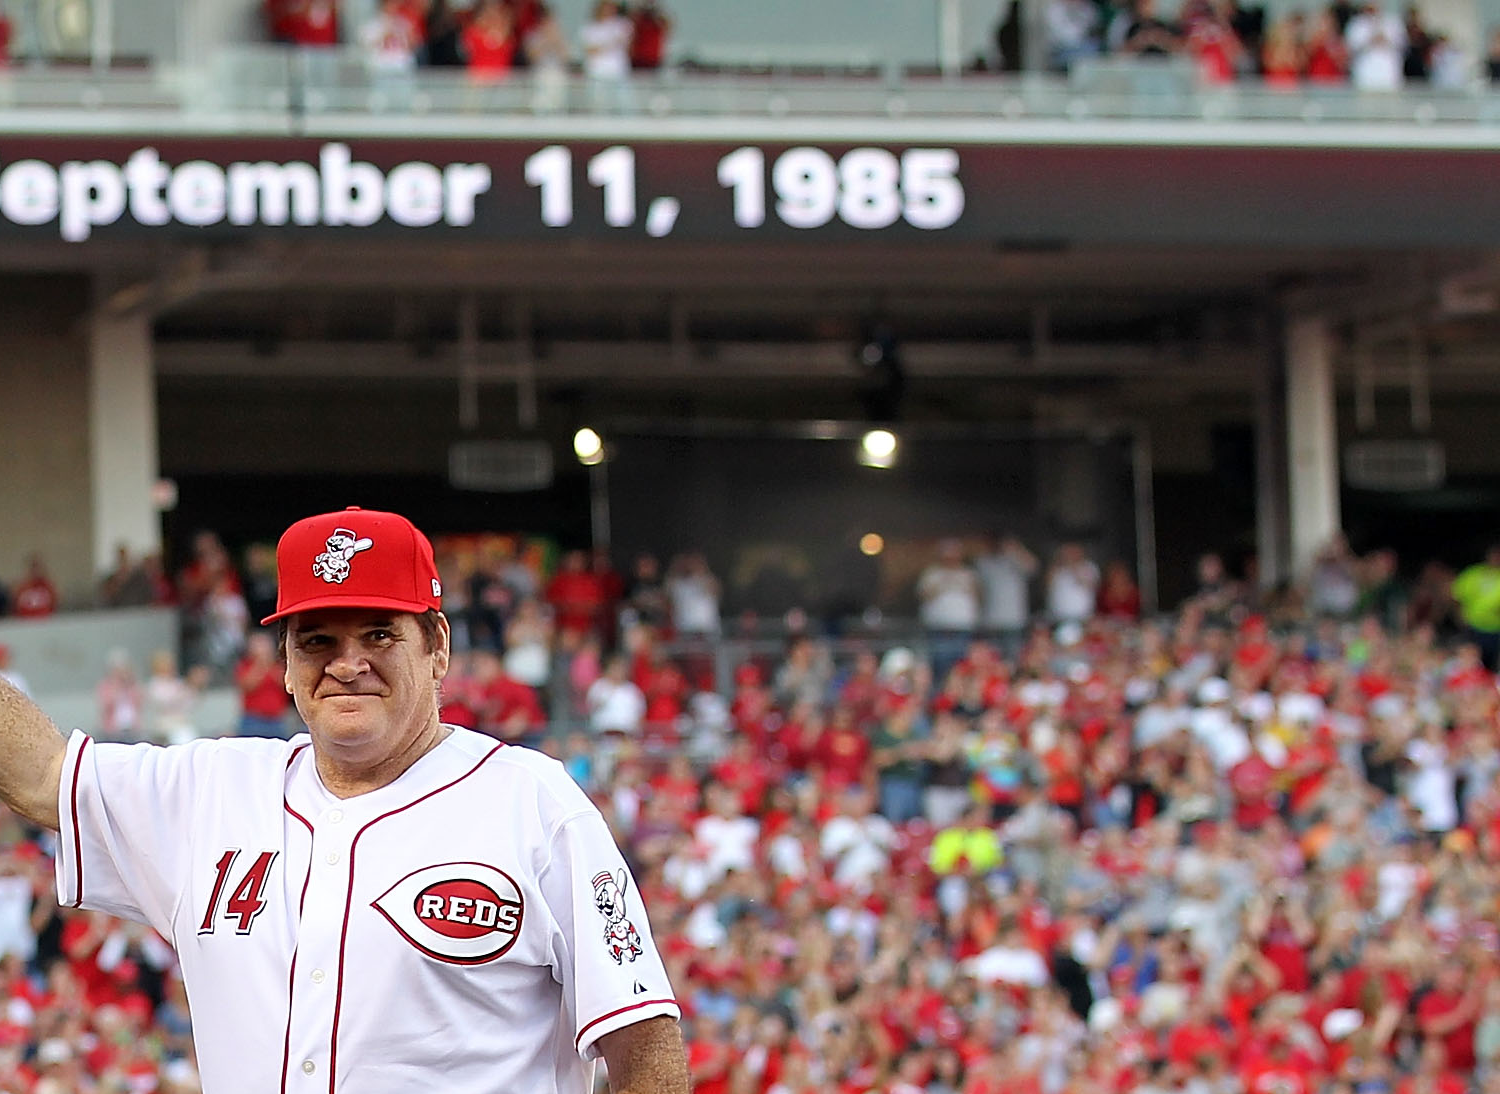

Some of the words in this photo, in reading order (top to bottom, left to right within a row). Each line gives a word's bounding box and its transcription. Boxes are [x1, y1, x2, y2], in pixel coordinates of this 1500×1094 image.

[524, 145, 681, 238] 11,
[717, 146, 966, 230] 1985
[197, 848, 280, 936] 14
[419, 894, 520, 932] REDS
